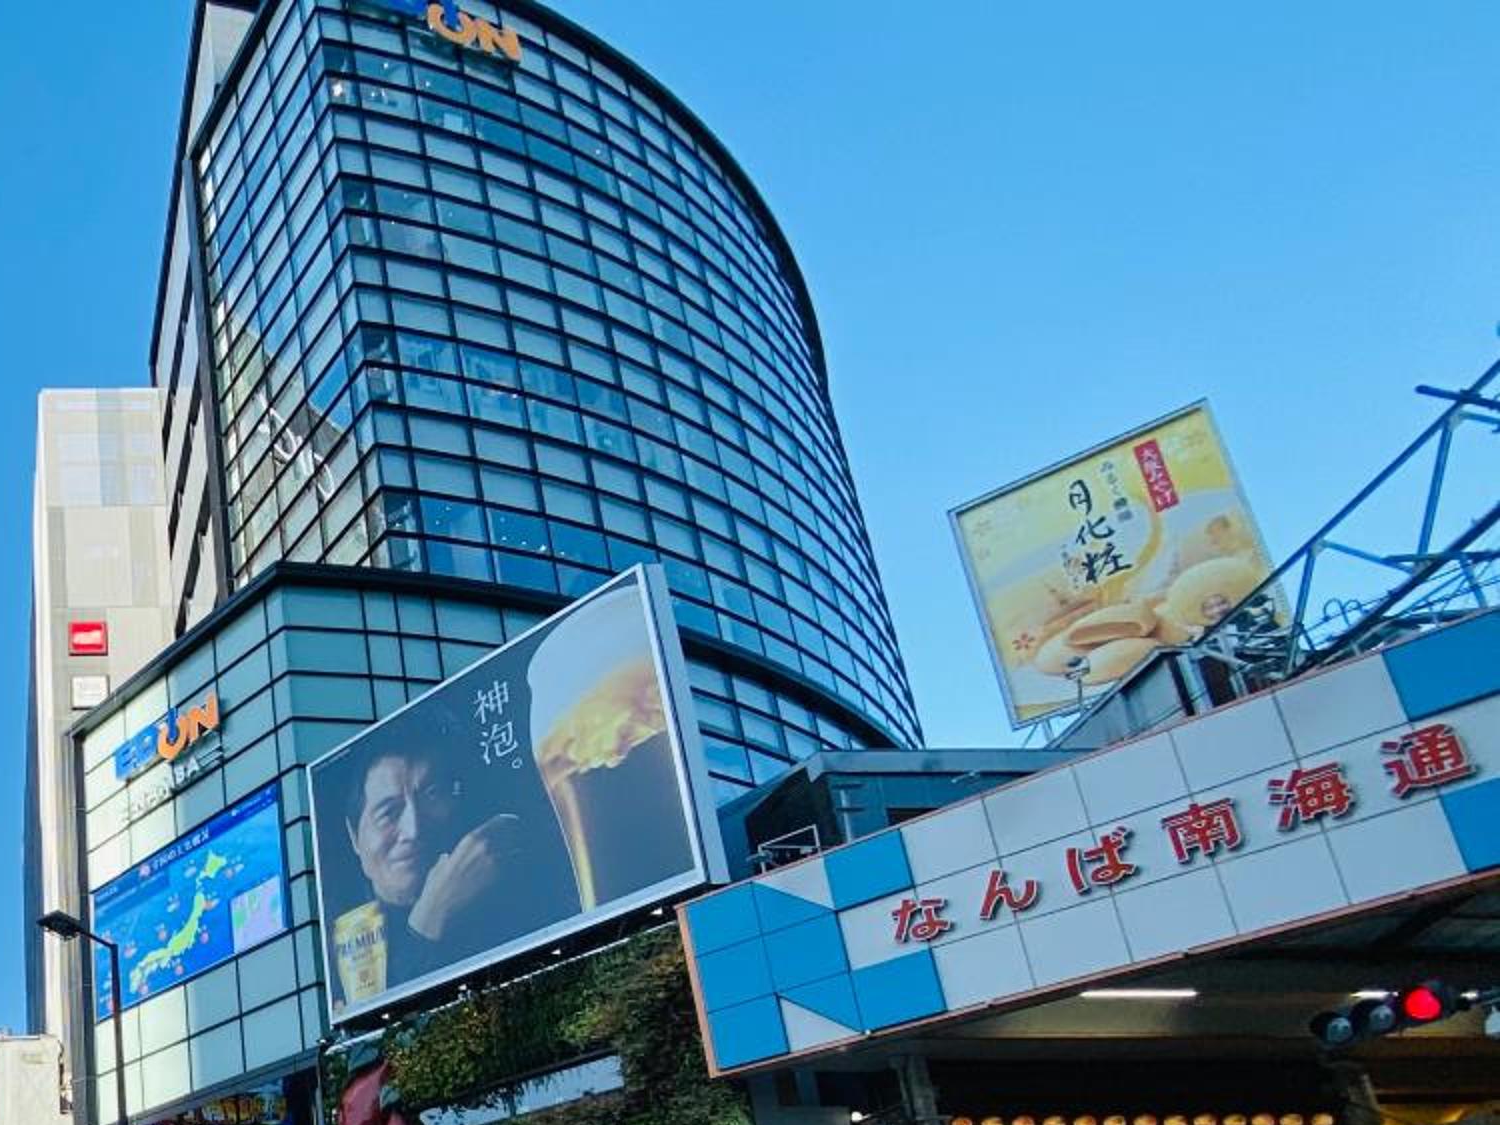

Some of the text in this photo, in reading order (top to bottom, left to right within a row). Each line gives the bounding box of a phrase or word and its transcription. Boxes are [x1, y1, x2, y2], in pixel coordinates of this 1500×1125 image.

[891, 723, 1478, 945] なんば南海通
